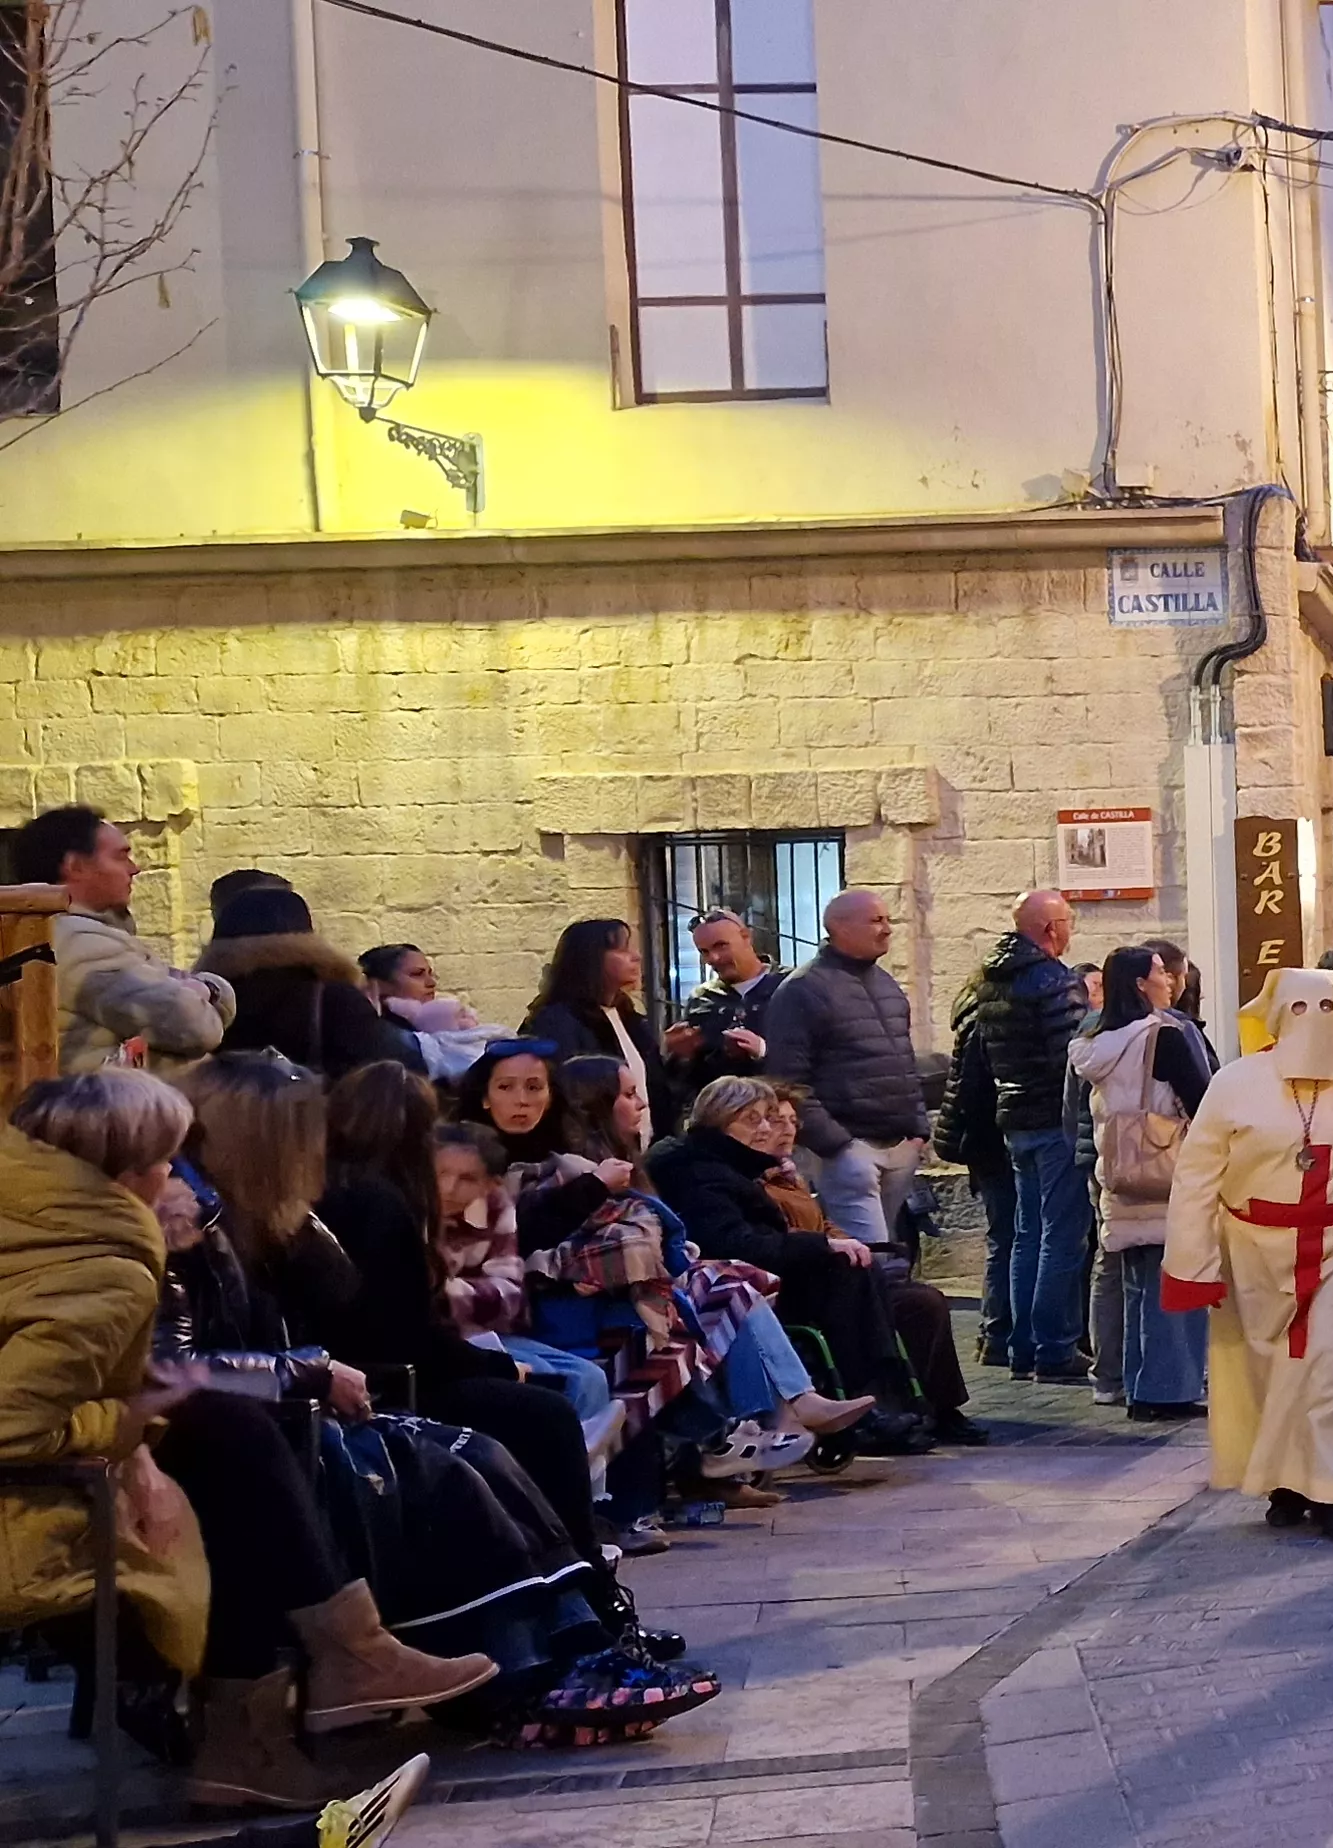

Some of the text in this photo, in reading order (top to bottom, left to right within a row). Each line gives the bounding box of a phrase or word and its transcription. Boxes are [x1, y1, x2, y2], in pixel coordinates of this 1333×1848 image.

[1150, 562, 1205, 578] CALLE
[1118, 592, 1219, 614] CASTILLA
[1073, 810, 1135, 821] Calle de CASTILLA
[1252, 831, 1286, 965] BAR E
